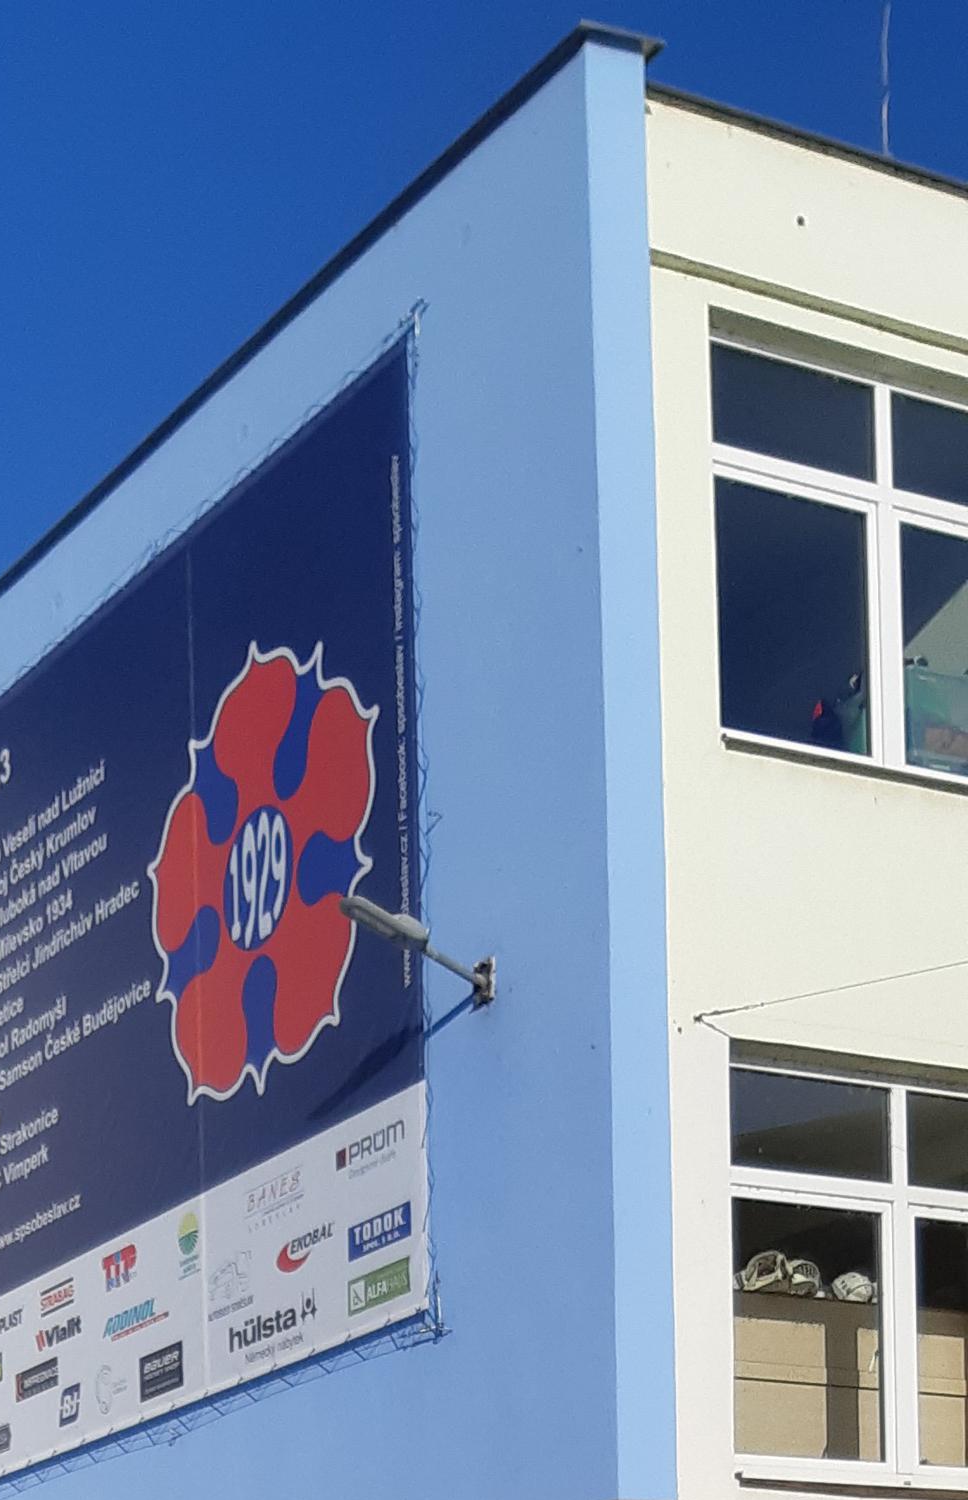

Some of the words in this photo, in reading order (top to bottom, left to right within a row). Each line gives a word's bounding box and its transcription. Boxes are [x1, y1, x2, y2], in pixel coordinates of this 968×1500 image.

[1, 814, 36, 857] Veselí
[37, 796, 60, 831] nad
[61, 759, 105, 812] Lužnicí
[9, 842, 45, 885] Český
[45, 806, 96, 859] Krumlov
[37, 863, 60, 898] nad
[61, 833, 107, 879] Vltavou
[94, 880, 140, 925] Hradec
[230, 811, 287, 949] 1929
[46, 888, 73, 925] 1934
[10, 995, 67, 1051] Radomyšl
[44, 1021, 81, 1061] České
[82, 979, 151, 1037] Budějovice
[0, 1107, 59, 1155] Strakonice
[348, 1119, 405, 1165] PRÜM
[2, 1143, 49, 1185] Vimperk
[290, 1222, 333, 1255] EKOBAL
[40, 1284, 74, 1311] STRABAG
[102, 1297, 157, 1339] ADDINOL
[44, 1315, 82, 1348] Vialit
[228, 1307, 297, 1353] hülsta
[144, 1350, 180, 1373] BAUER
